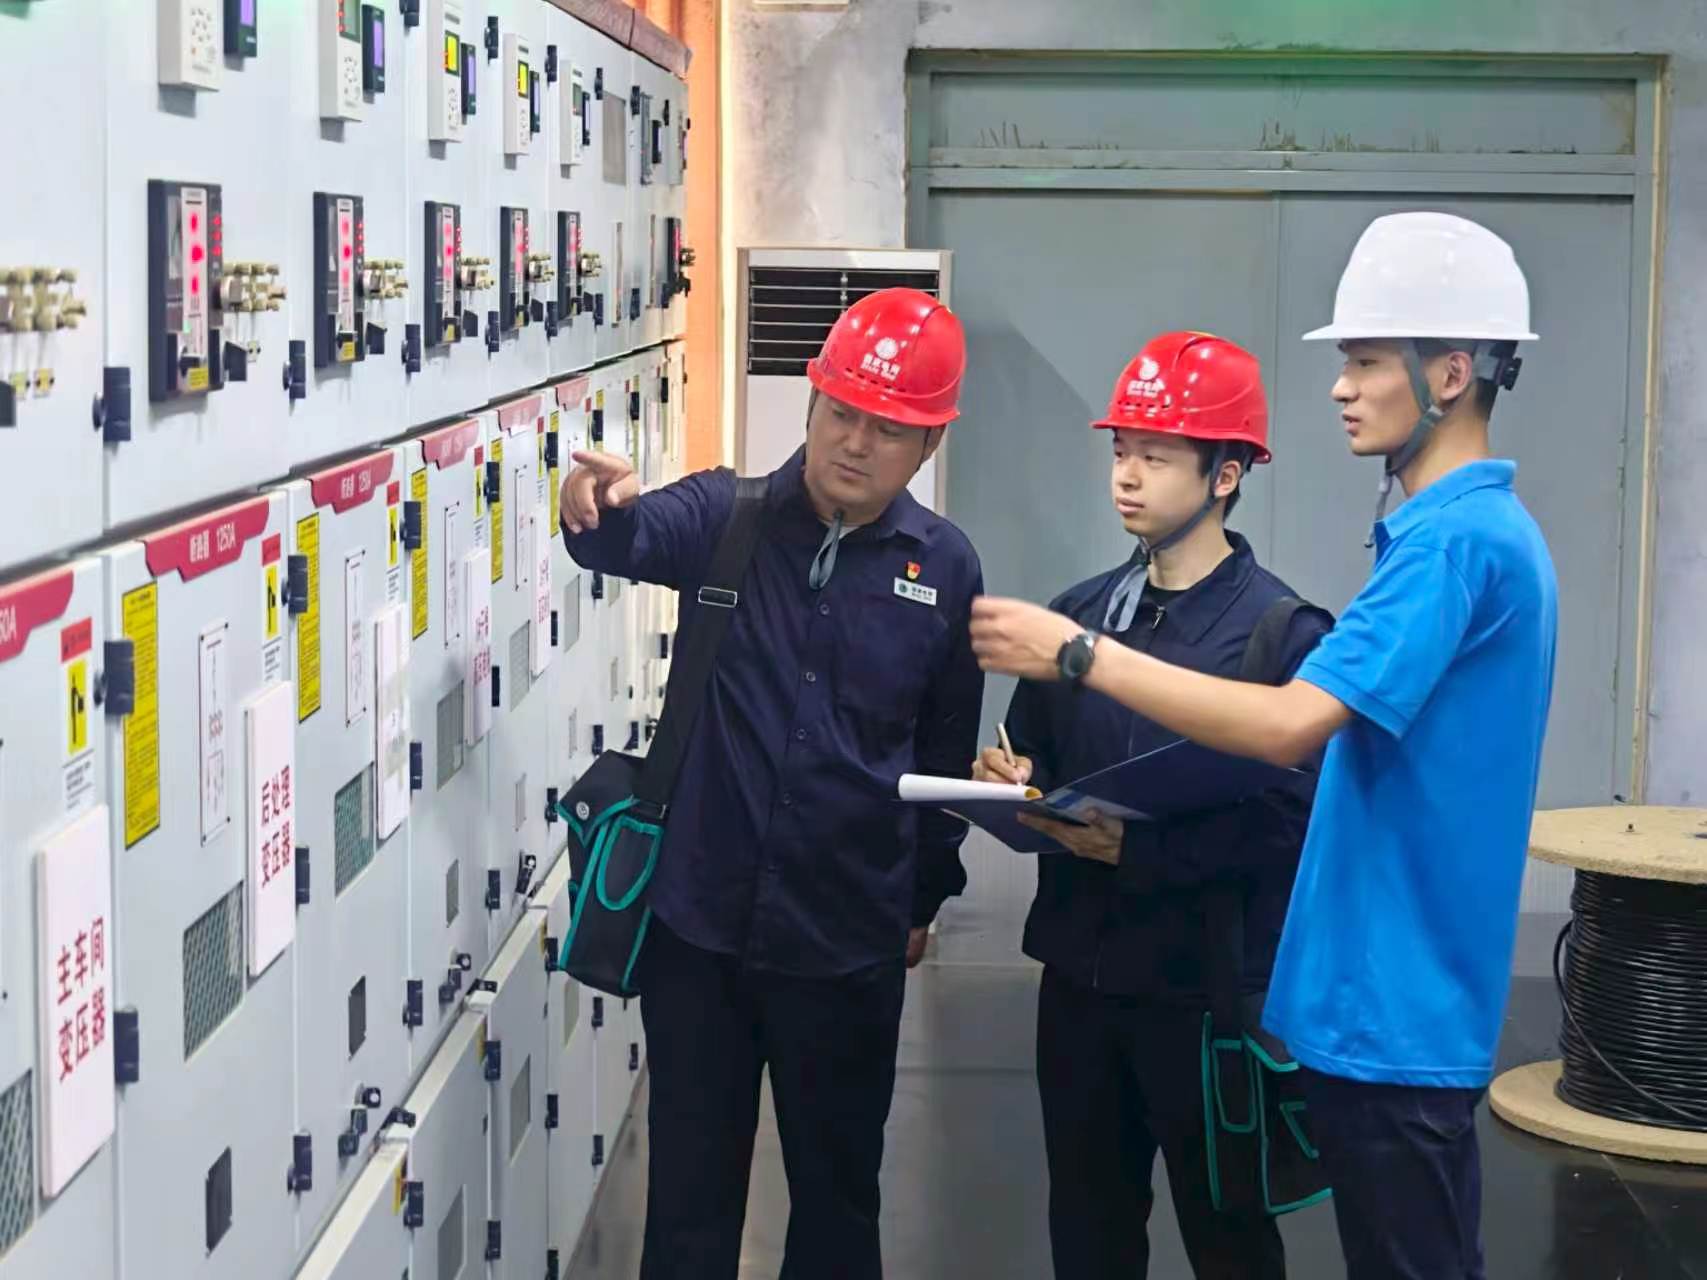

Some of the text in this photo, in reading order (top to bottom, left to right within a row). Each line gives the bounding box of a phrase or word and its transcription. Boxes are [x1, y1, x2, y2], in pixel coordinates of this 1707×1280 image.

[261, 820, 290, 889] 变压器
[57, 915, 105, 1006] 主车间
[58, 985, 105, 1084] 变压器
